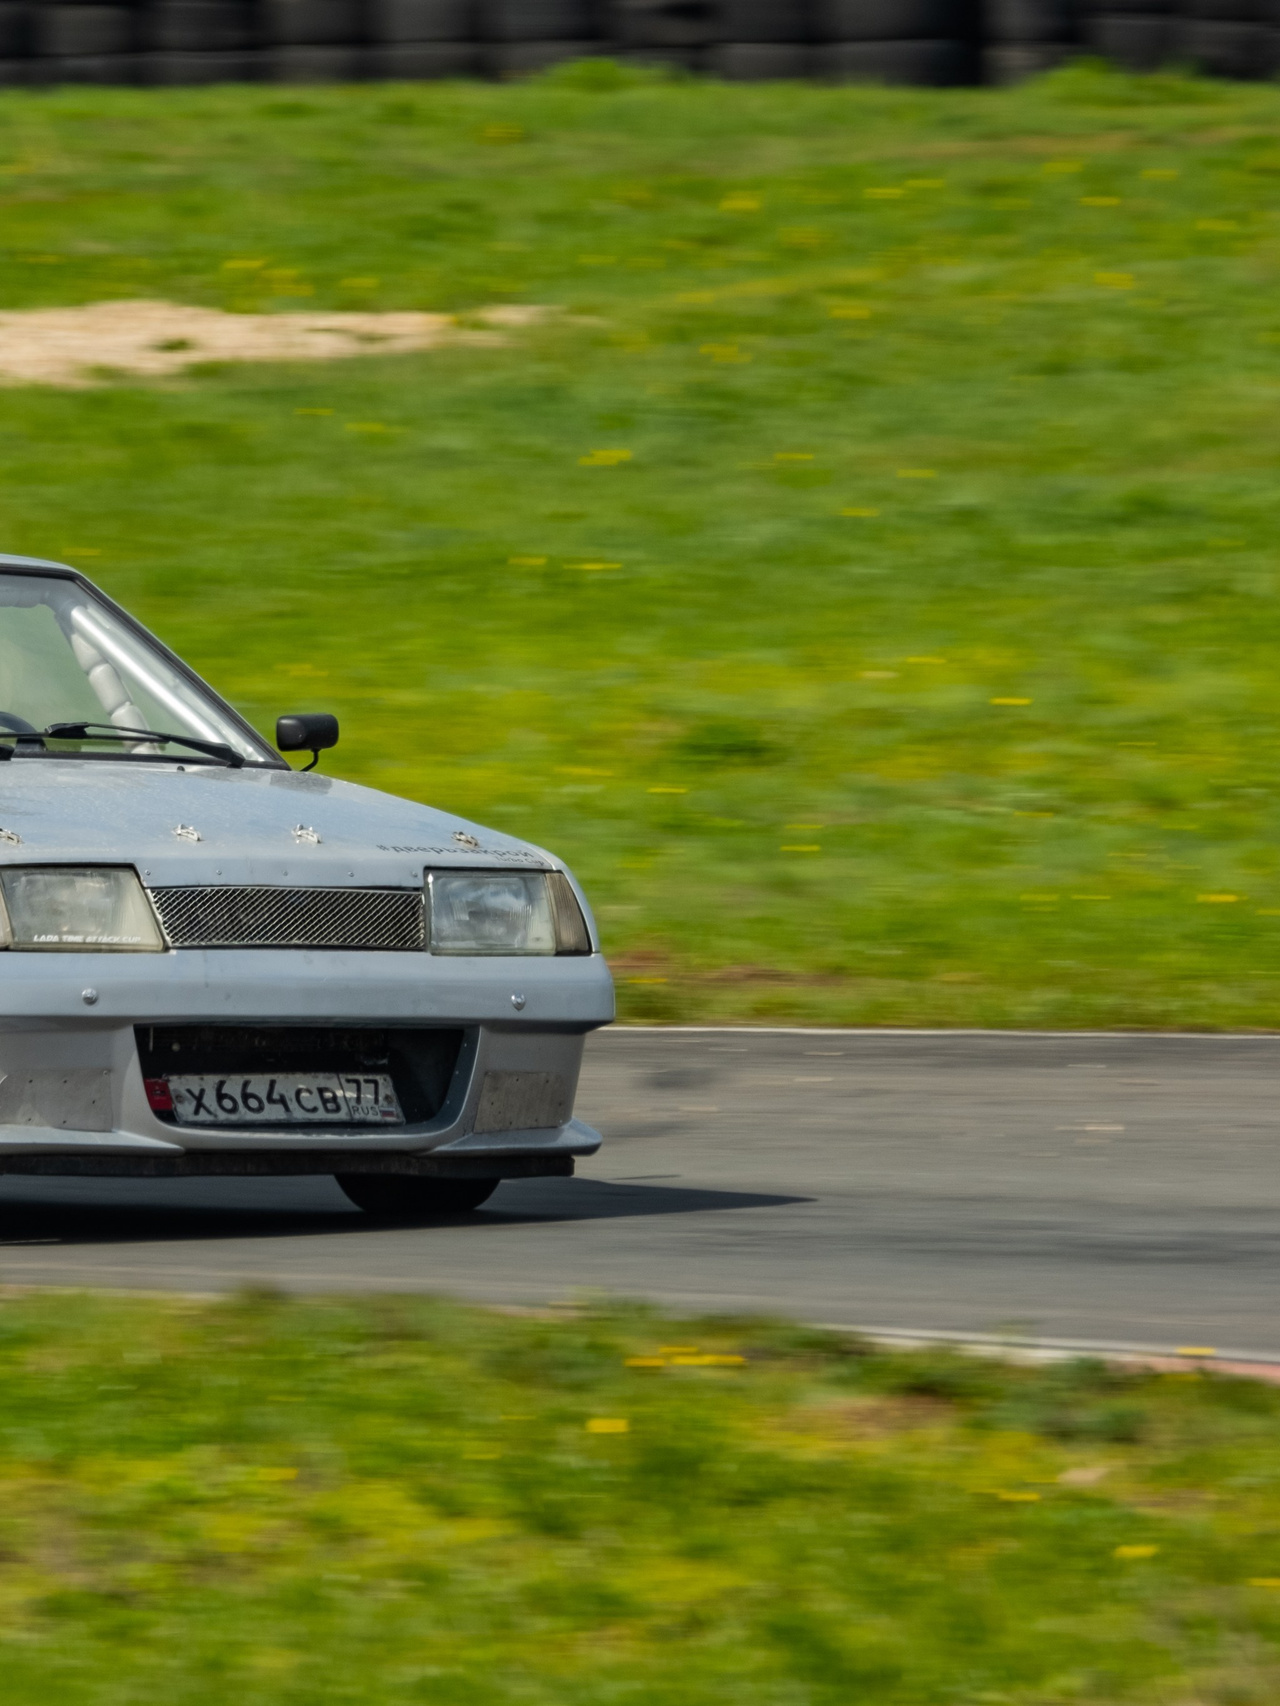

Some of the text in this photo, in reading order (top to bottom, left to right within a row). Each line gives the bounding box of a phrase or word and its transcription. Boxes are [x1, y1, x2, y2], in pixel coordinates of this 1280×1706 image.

[33, 934, 59, 943] LADA
[85, 935, 120, 944] ATTACK
[122, 936, 141, 944] CUP
[345, 1078, 379, 1105] 77
[353, 1106, 379, 1117] RUS
